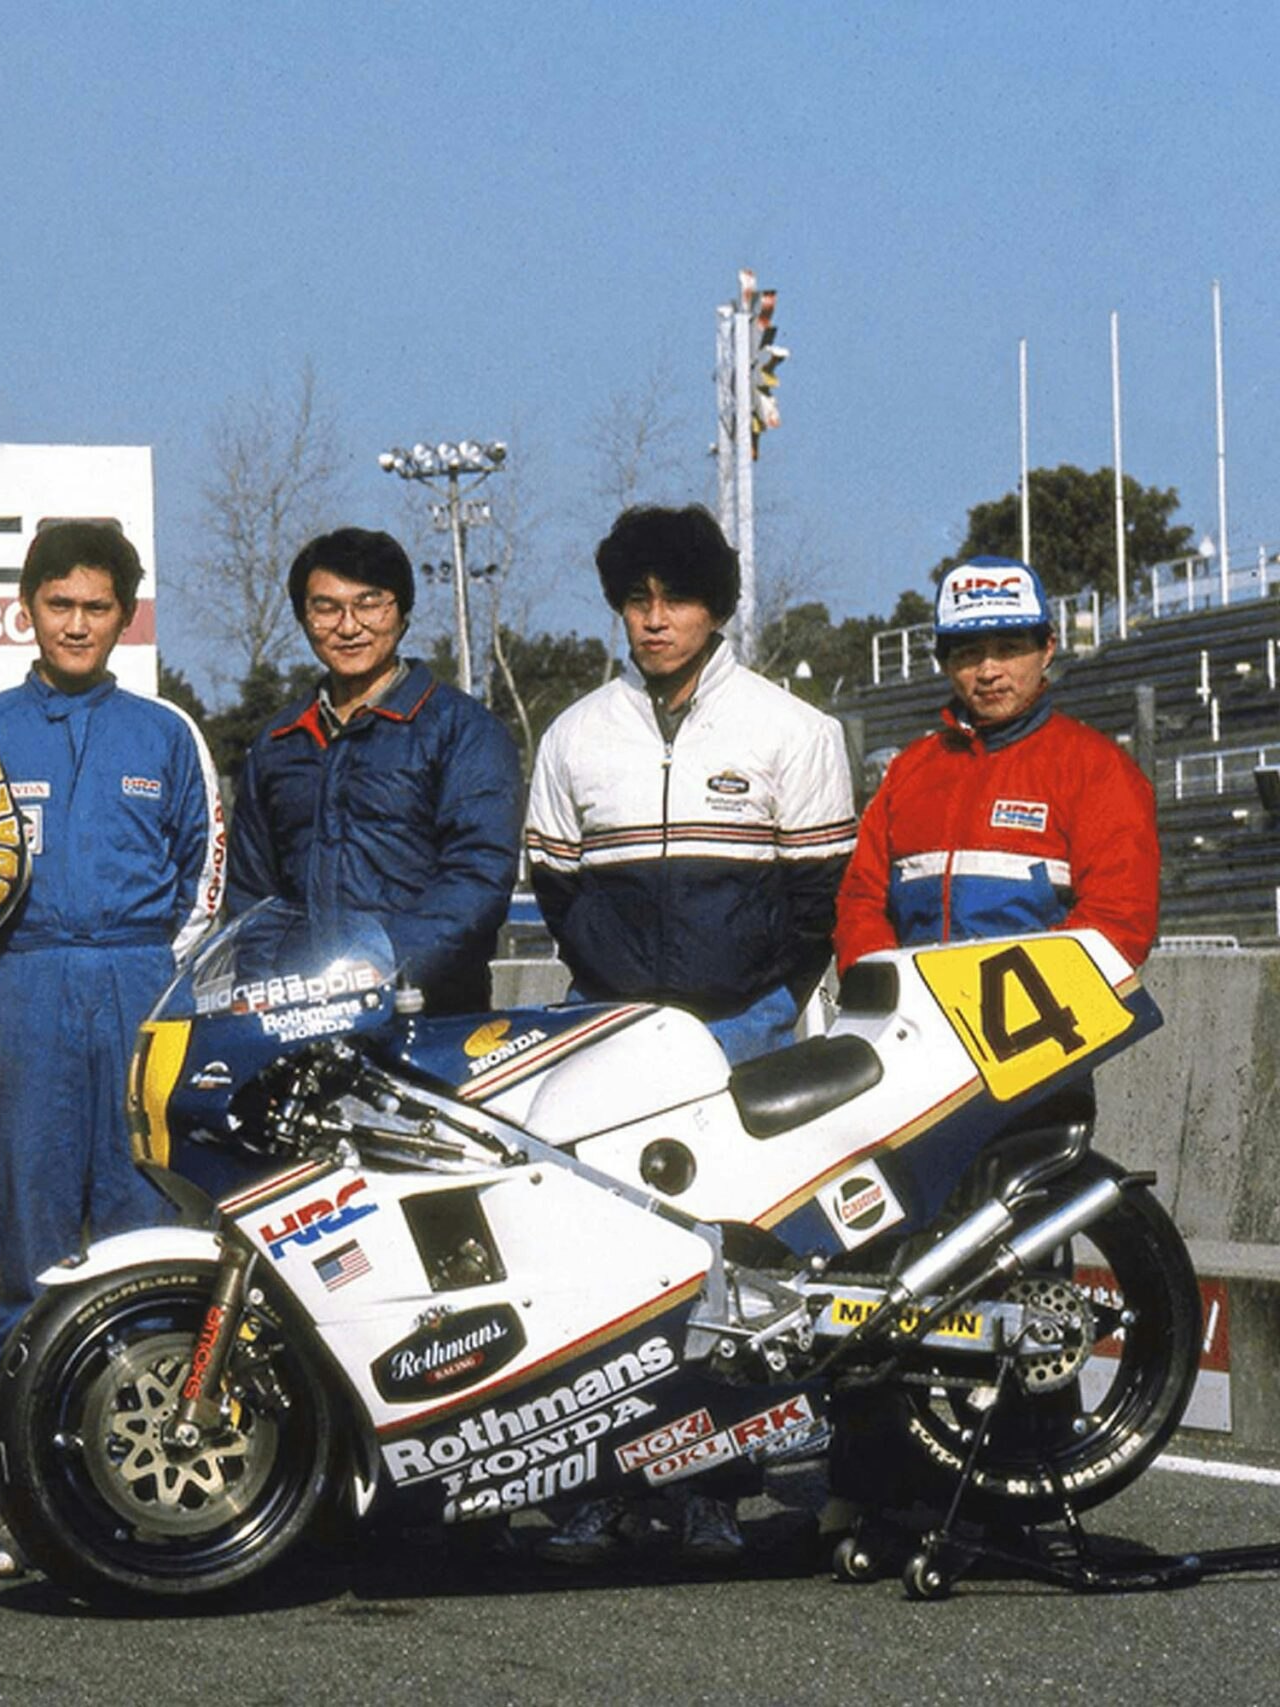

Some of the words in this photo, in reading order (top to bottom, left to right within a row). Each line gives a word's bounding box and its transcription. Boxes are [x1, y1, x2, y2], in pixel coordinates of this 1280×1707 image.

[951, 577, 1021, 605] HRC
[995, 803, 1046, 822] HRC
[246, 967, 375, 1015] FREDDIE
[980, 945, 1086, 1063] 4
[262, 1000, 363, 1035] Rothmans
[280, 1019, 356, 1043] HONDA
[468, 1029, 547, 1076] HONDA
[259, 1178, 378, 1260] HRC
[183, 1305, 223, 1400] SHOWA
[391, 1319, 508, 1381] Rothmans
[380, 1336, 675, 1483] Rothmans
[734, 1401, 806, 1446] RK
[620, 1419, 699, 1472] NGK
[652, 1441, 718, 1476] OKI
